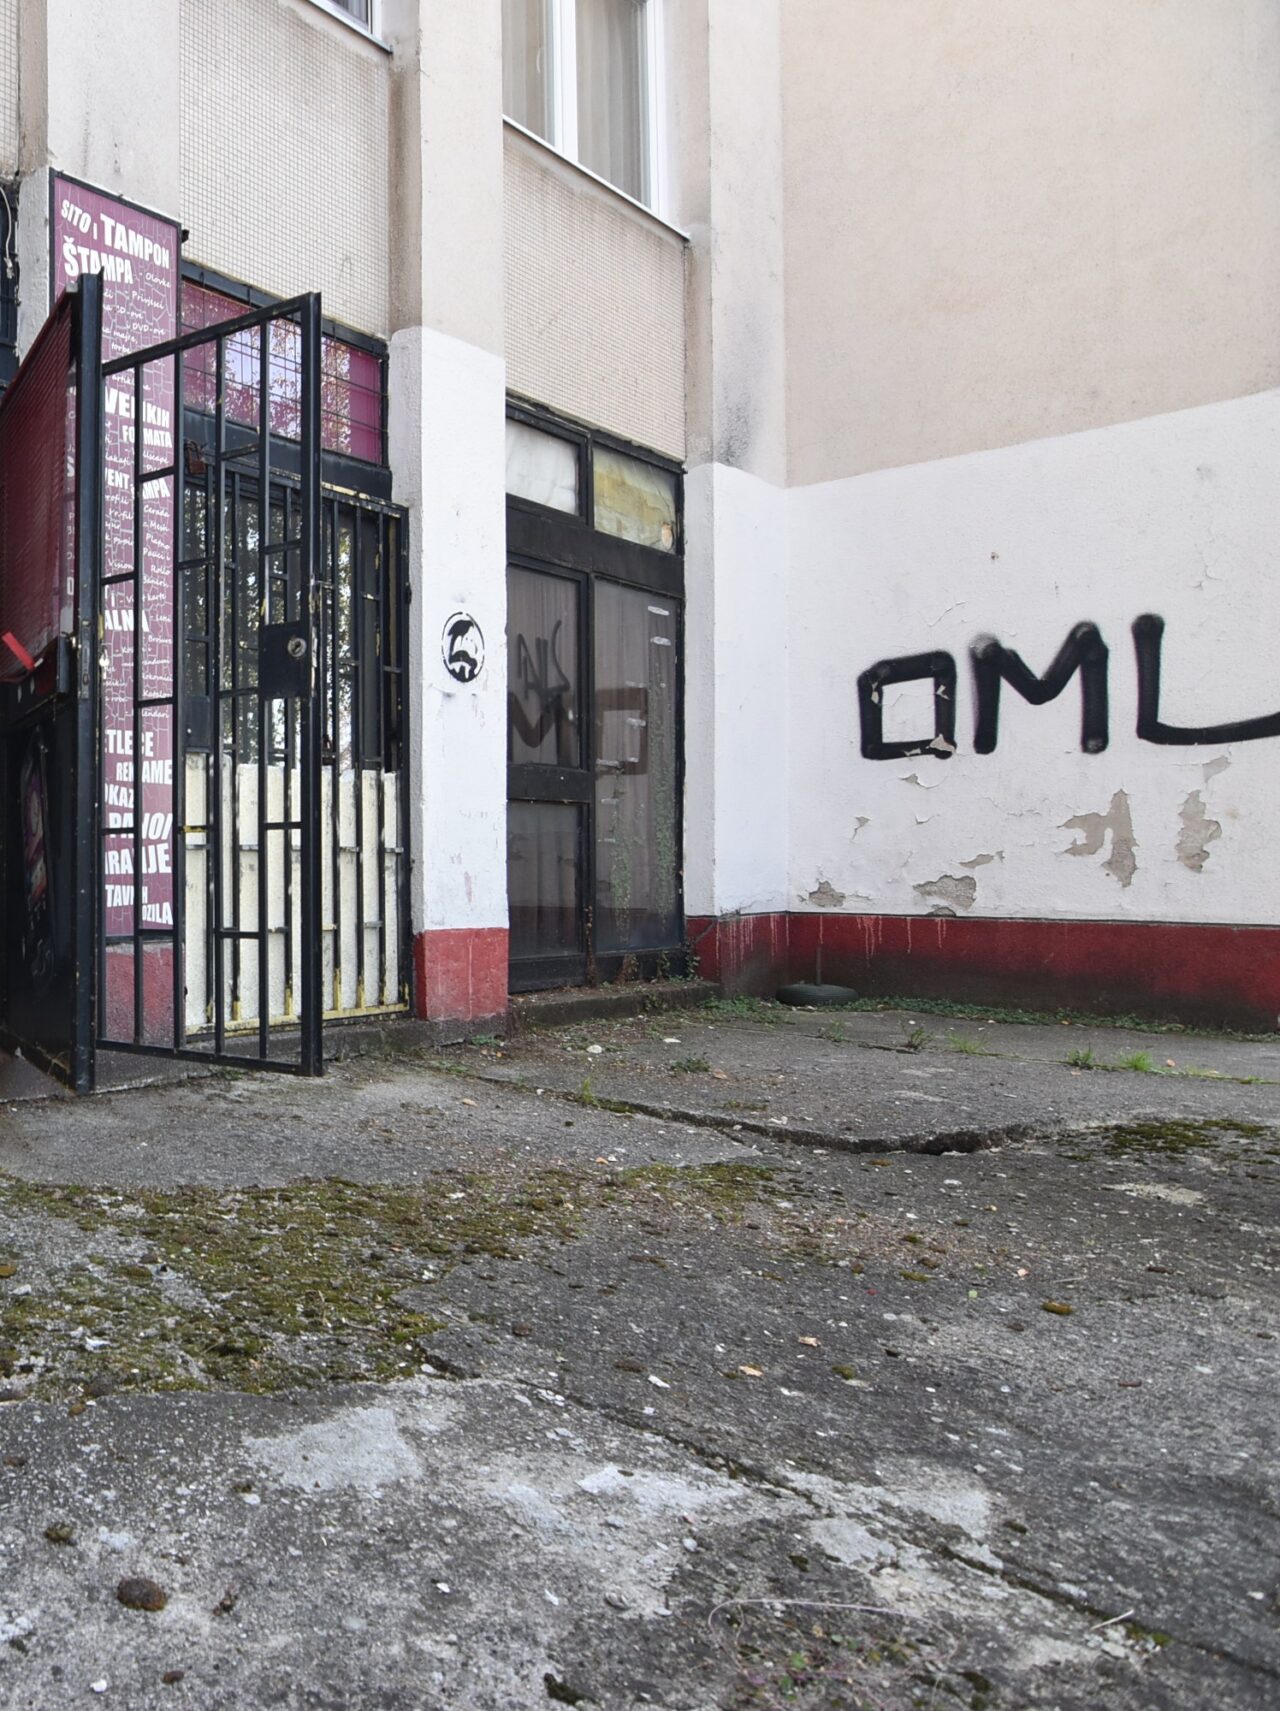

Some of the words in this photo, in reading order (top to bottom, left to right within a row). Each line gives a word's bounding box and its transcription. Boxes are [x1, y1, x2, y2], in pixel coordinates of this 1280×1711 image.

[61, 199, 91, 234] SITO
[100, 213, 170, 269] TAMPON
[63, 235, 134, 285] ŠTAMPA
